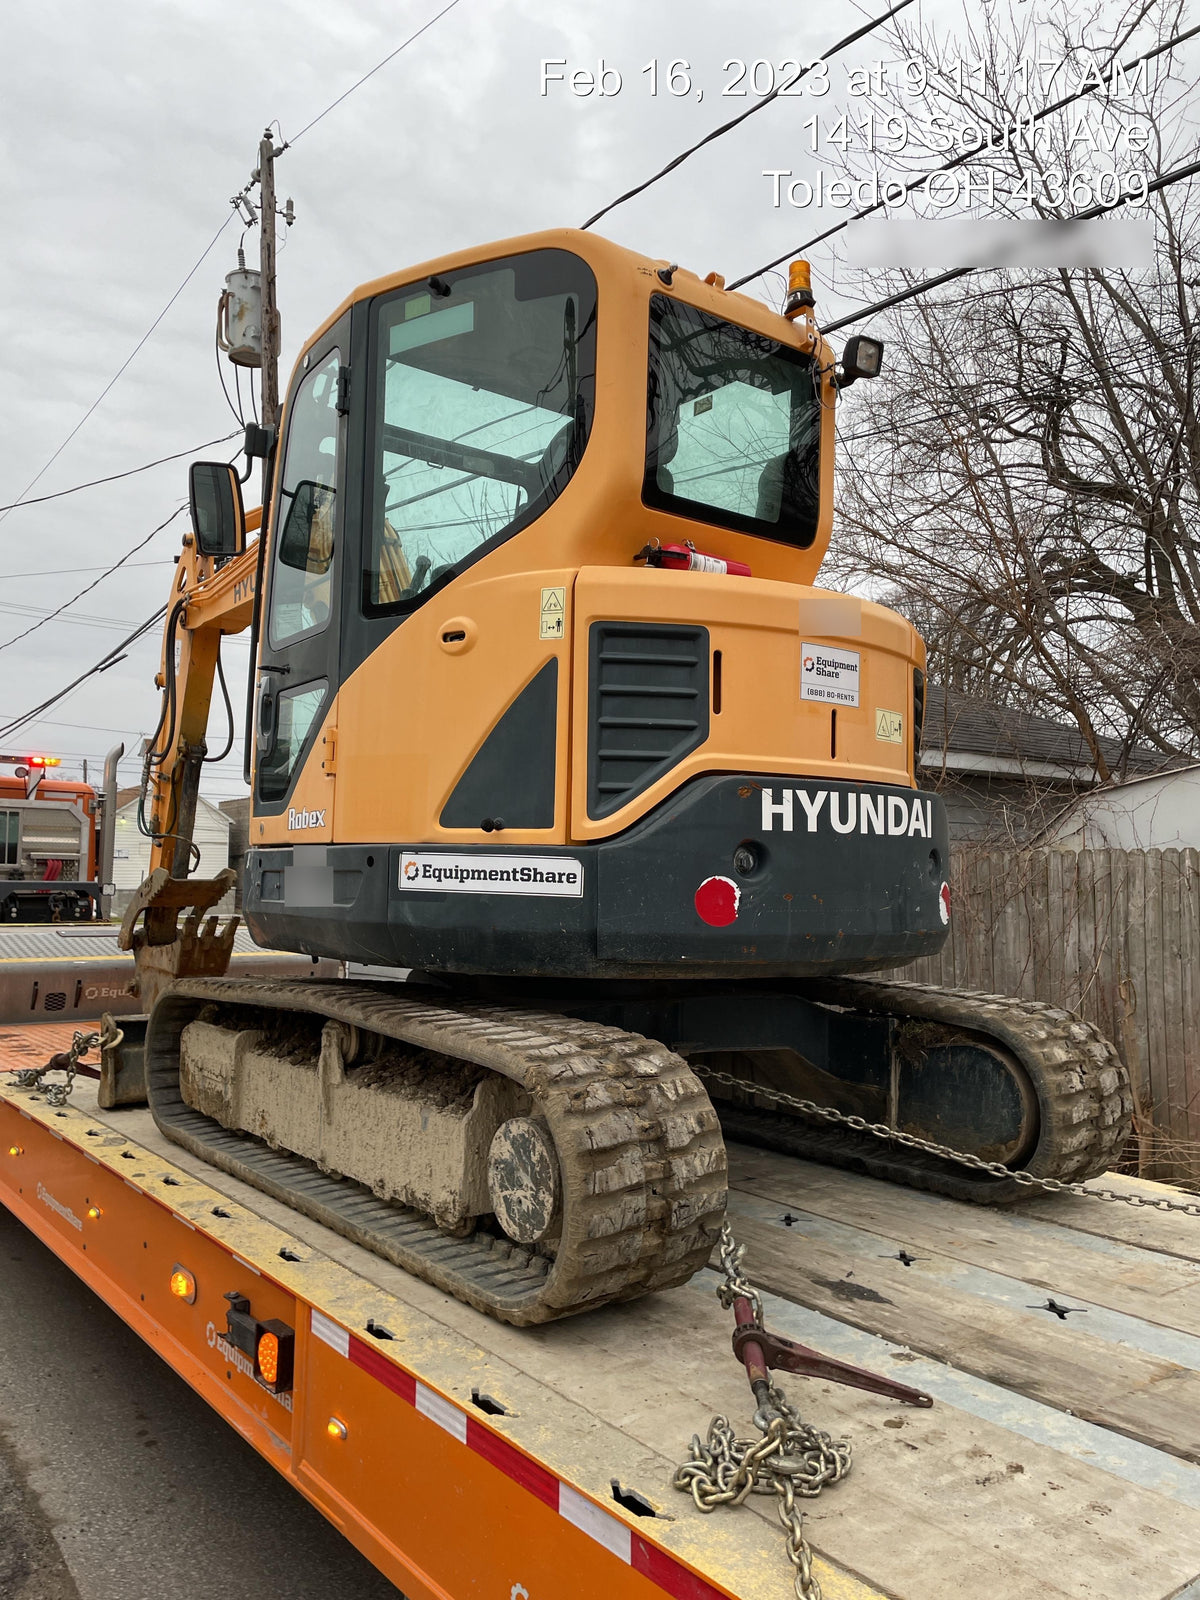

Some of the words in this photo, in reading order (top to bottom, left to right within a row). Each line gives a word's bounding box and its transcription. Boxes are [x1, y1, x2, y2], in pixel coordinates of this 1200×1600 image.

[815, 667, 840, 679] Share
[816, 656, 858, 672] Equipment
[807, 687, 825, 698] (888)
[826, 691, 855, 702] 80-RENTS
[288, 806, 326, 831] Robex
[761, 788, 932, 839] HYUNDAI
[421, 863, 578, 885] EquipmentShare
